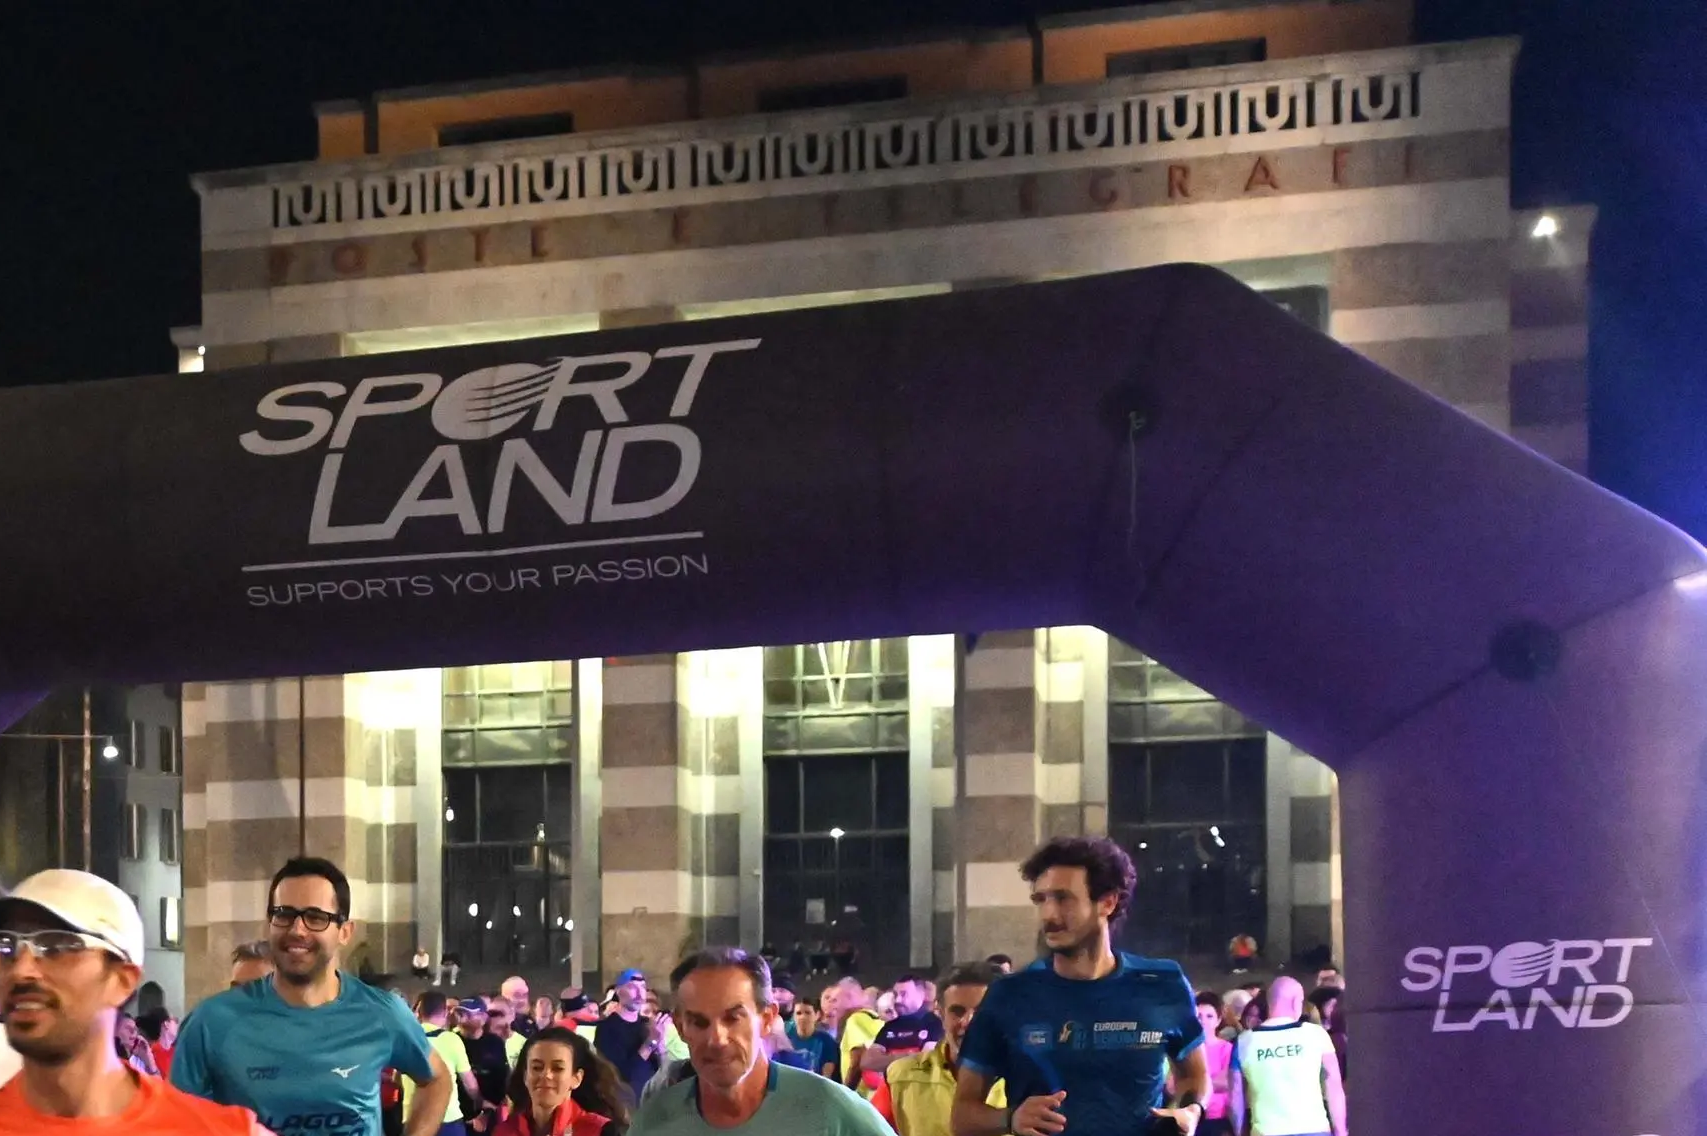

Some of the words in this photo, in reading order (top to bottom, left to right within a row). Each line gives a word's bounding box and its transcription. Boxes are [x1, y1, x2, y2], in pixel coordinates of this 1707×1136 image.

[239, 338, 762, 456] SPORT
[308, 423, 702, 544] LAND
[247, 574, 434, 607] SUPPORTS
[447, 567, 542, 595] YOUR
[552, 554, 709, 584] PASSION
[1401, 938, 1653, 991] SPORT
[1432, 985, 1634, 1033] LAND
[1257, 1045, 1303, 1061] PACER
